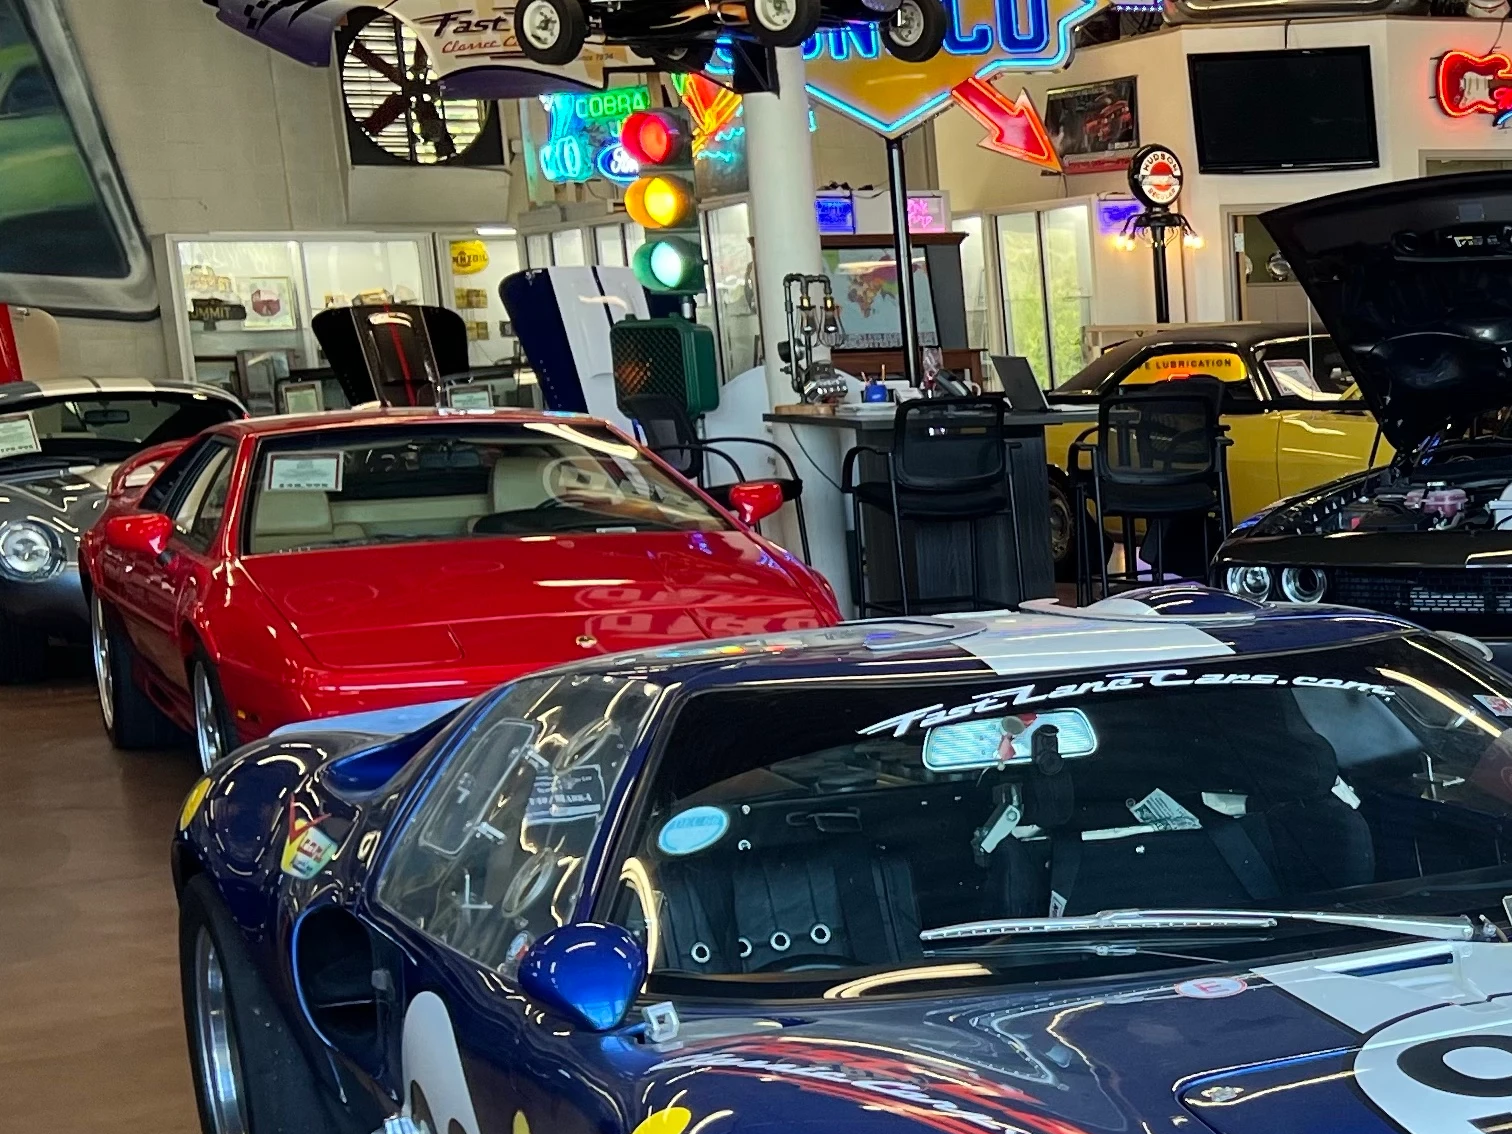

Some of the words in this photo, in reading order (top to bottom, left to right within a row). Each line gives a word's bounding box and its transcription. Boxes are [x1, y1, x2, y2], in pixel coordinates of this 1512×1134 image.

[411, 9, 511, 38] Fast
[575, 92, 646, 119] COBRA
[1143, 153, 1178, 172] HUDSON
[191, 306, 231, 319] UMMIT
[1156, 358, 1232, 370] LUBRICATION
